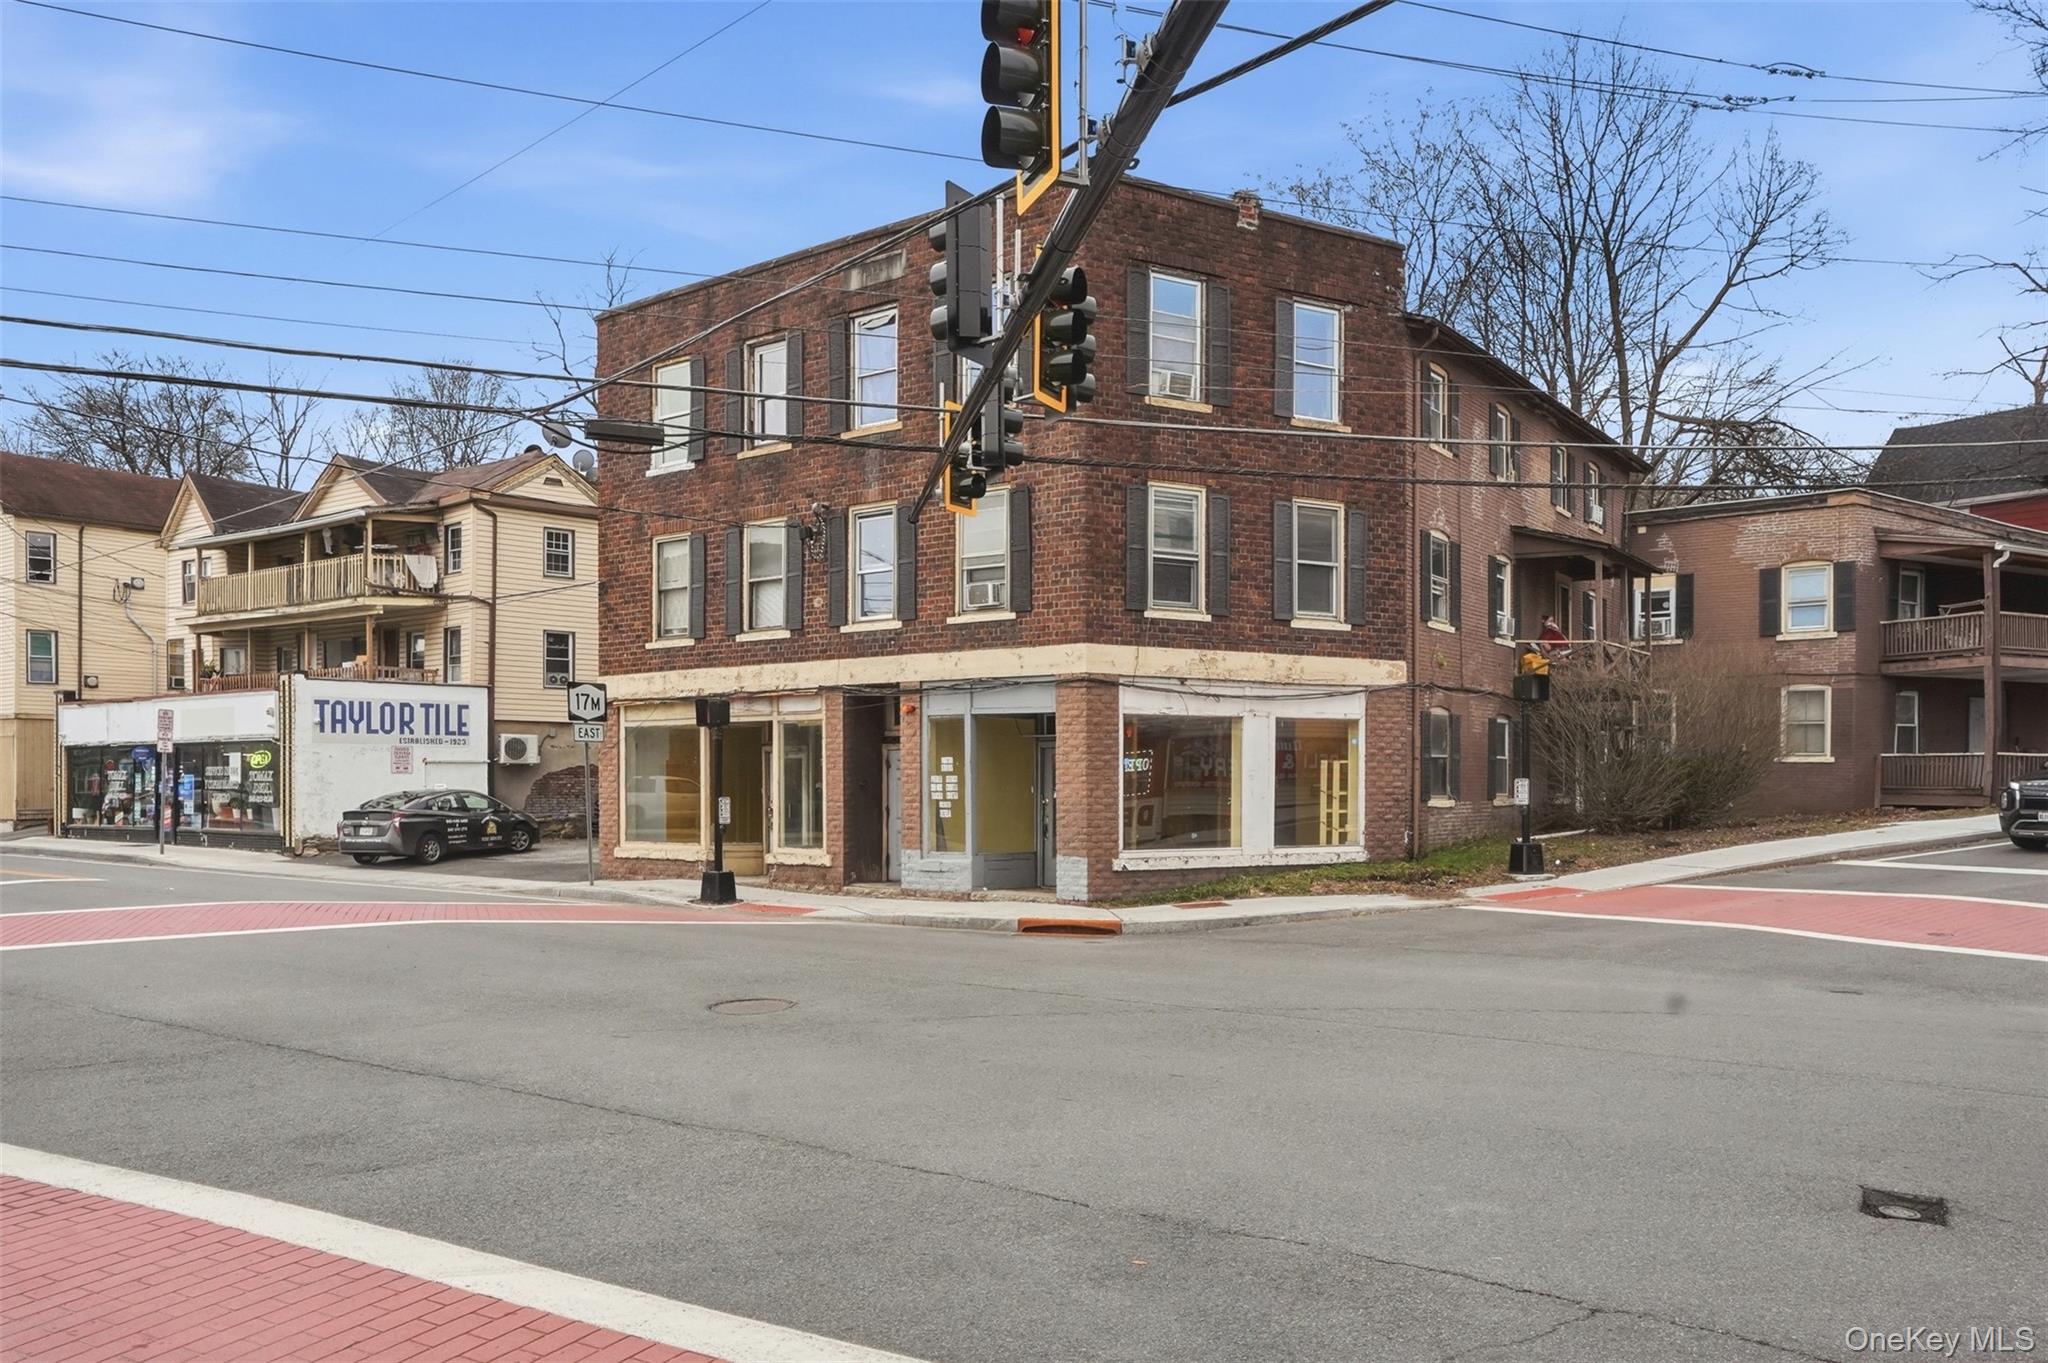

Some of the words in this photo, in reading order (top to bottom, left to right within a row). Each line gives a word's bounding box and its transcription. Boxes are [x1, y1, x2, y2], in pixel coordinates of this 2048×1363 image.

[575, 692, 601, 711] 17M
[314, 699, 415, 735] TAYLOR
[420, 703, 469, 736] TILE
[578, 727, 600, 739] EAST
